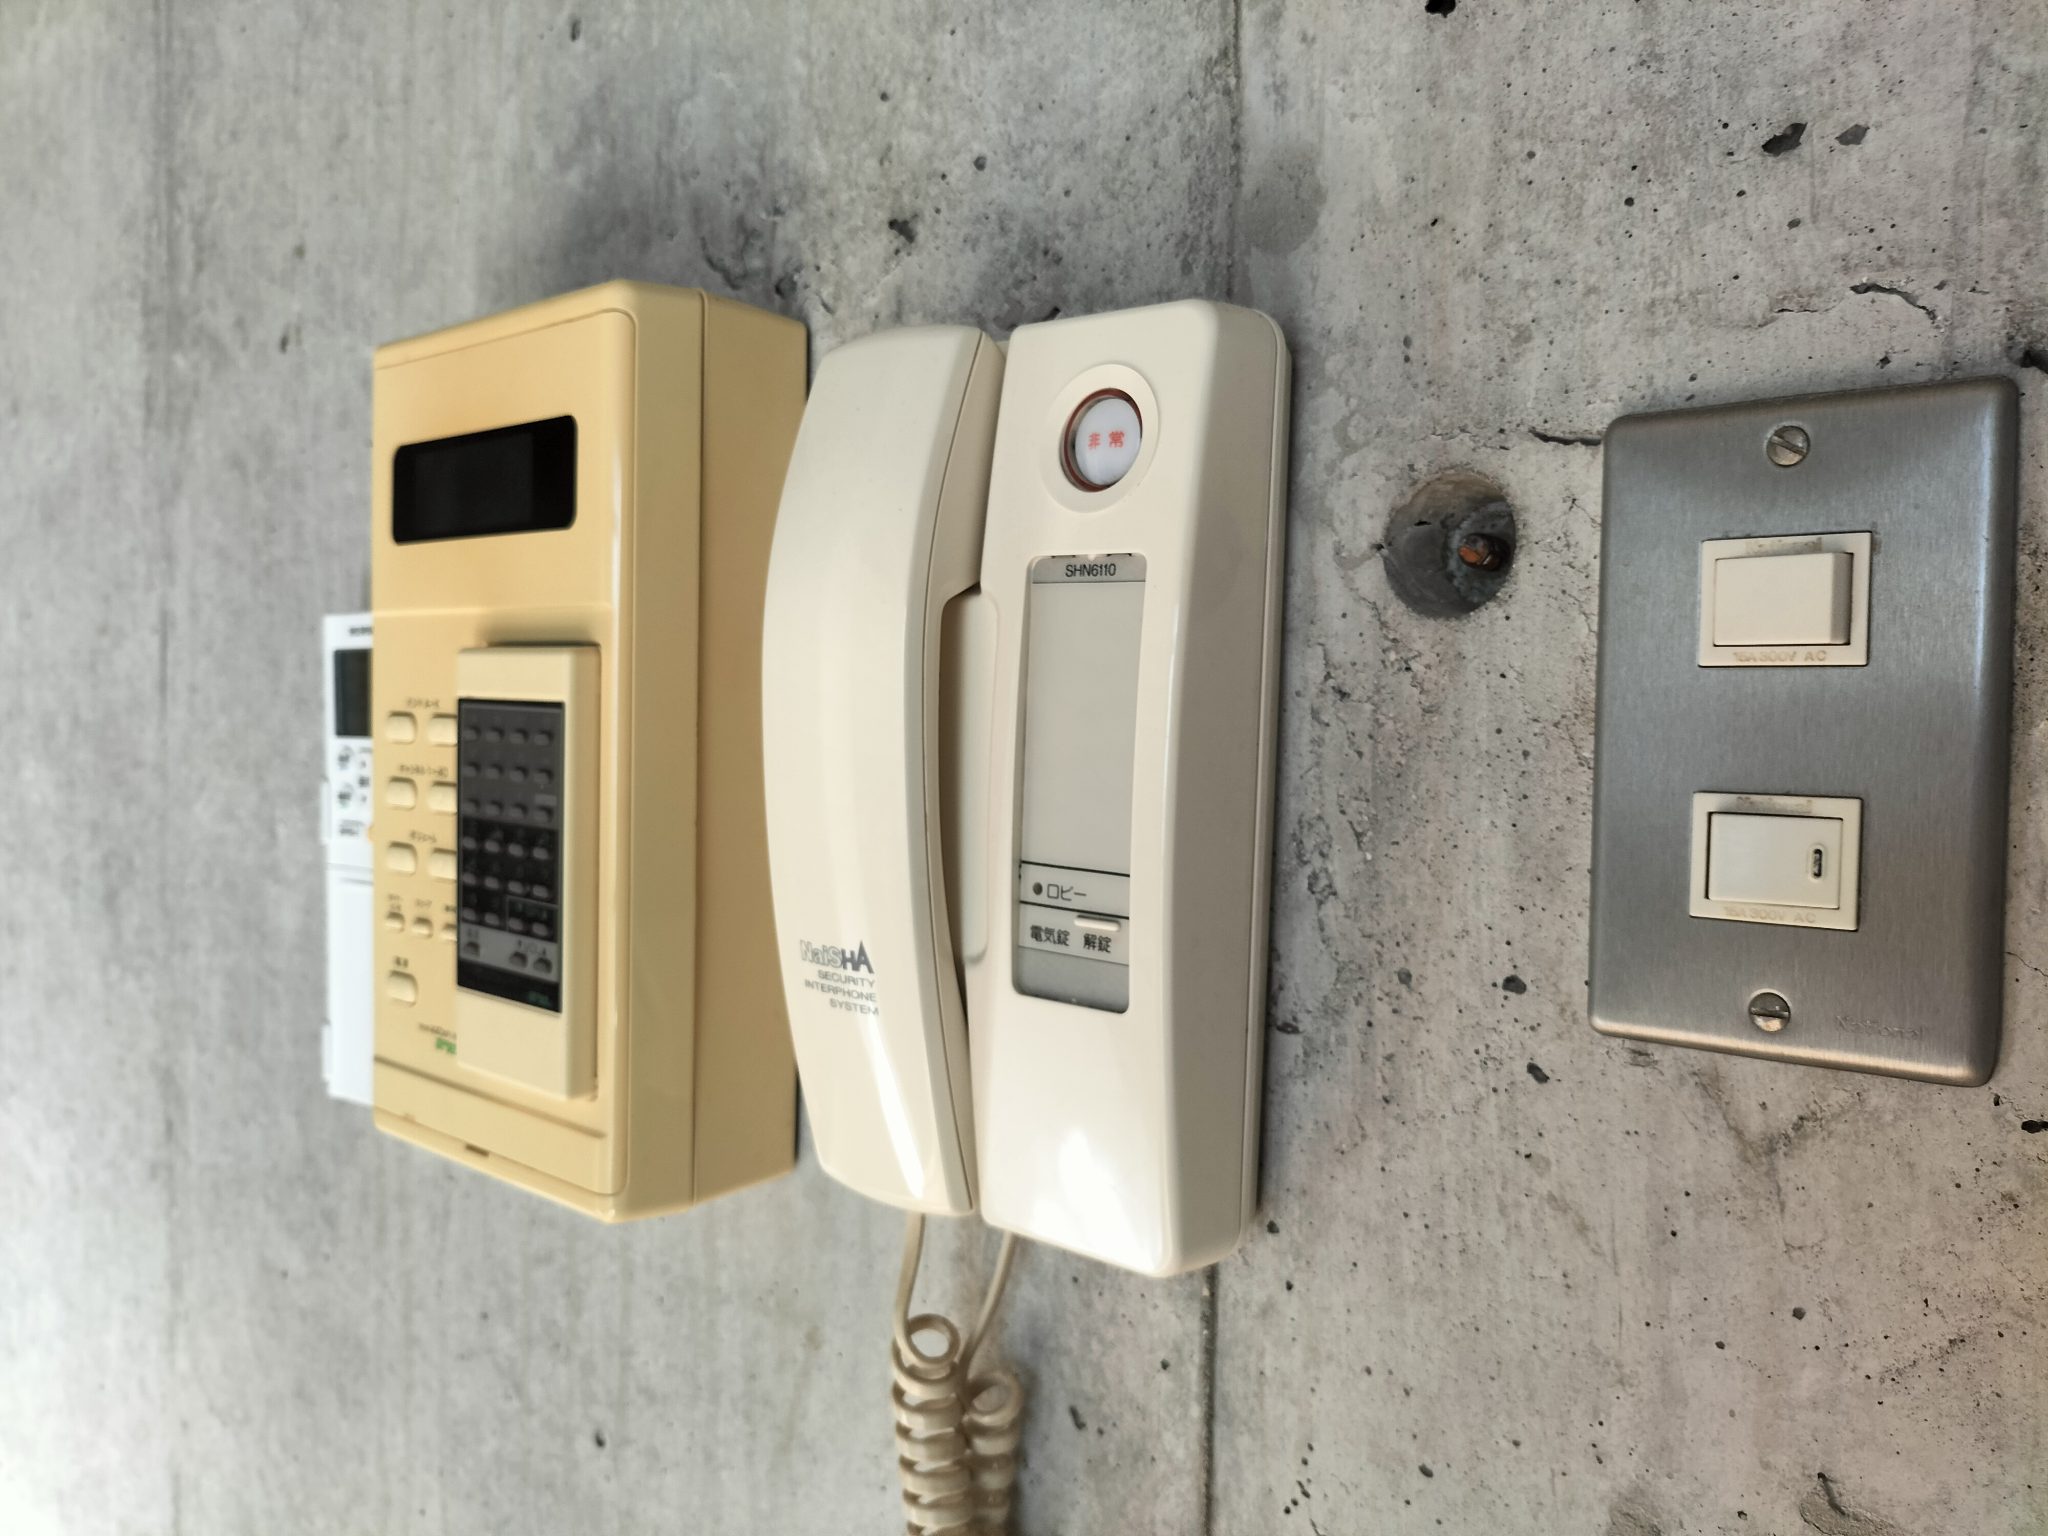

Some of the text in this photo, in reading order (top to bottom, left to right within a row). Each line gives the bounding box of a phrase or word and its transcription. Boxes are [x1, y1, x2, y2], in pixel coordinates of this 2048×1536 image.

[1087, 431, 1125, 449] 非常
[1065, 563, 1117, 578] SHN6110
[1046, 883, 1087, 902] ロビー
[1030, 924, 1112, 954] 電気錠 解錠
[817, 968, 876, 989] SECURITY
[804, 978, 878, 1002] INTERPHONE
[828, 997, 880, 1016] SYSTEM
